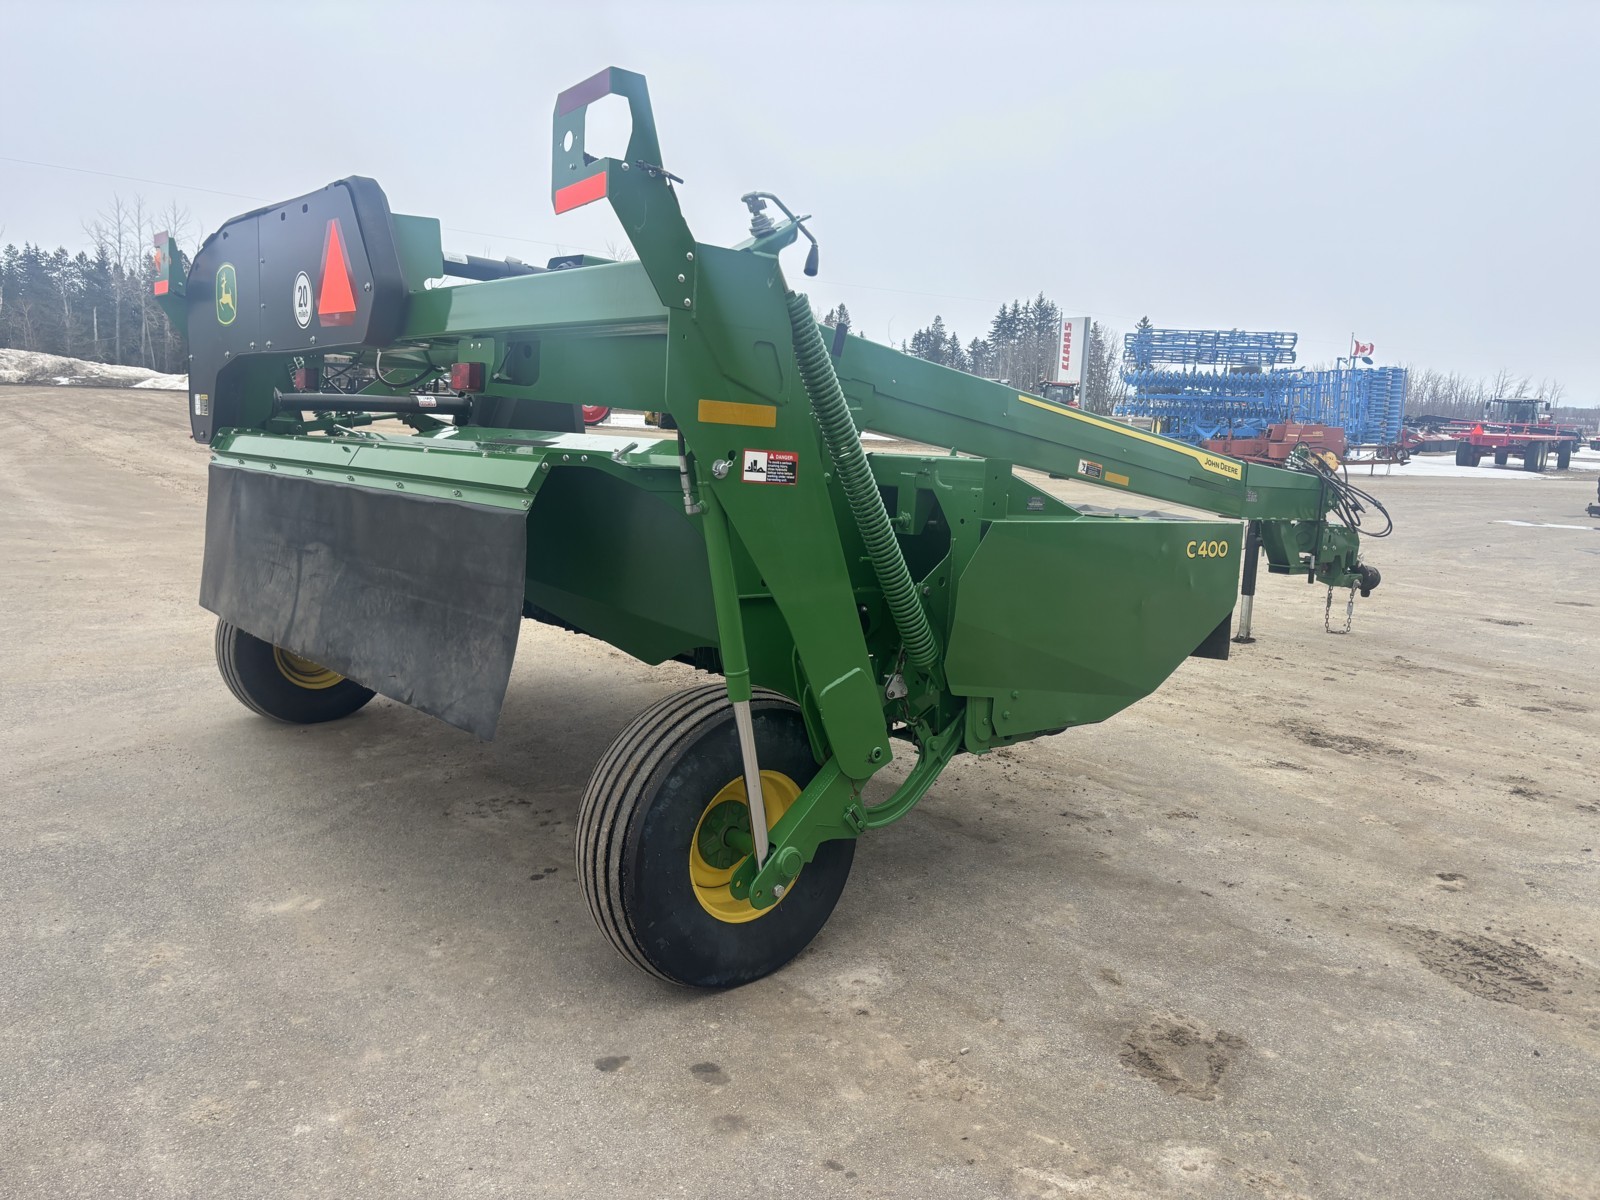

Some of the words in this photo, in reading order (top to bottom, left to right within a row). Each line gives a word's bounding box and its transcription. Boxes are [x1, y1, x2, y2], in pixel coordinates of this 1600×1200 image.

[298, 285, 308, 308] 20
[1062, 322, 1072, 370] CLAAS
[1204, 458, 1220, 469] JOHN
[1220, 462, 1238, 474] DEERE
[1186, 540, 1228, 558] C400
